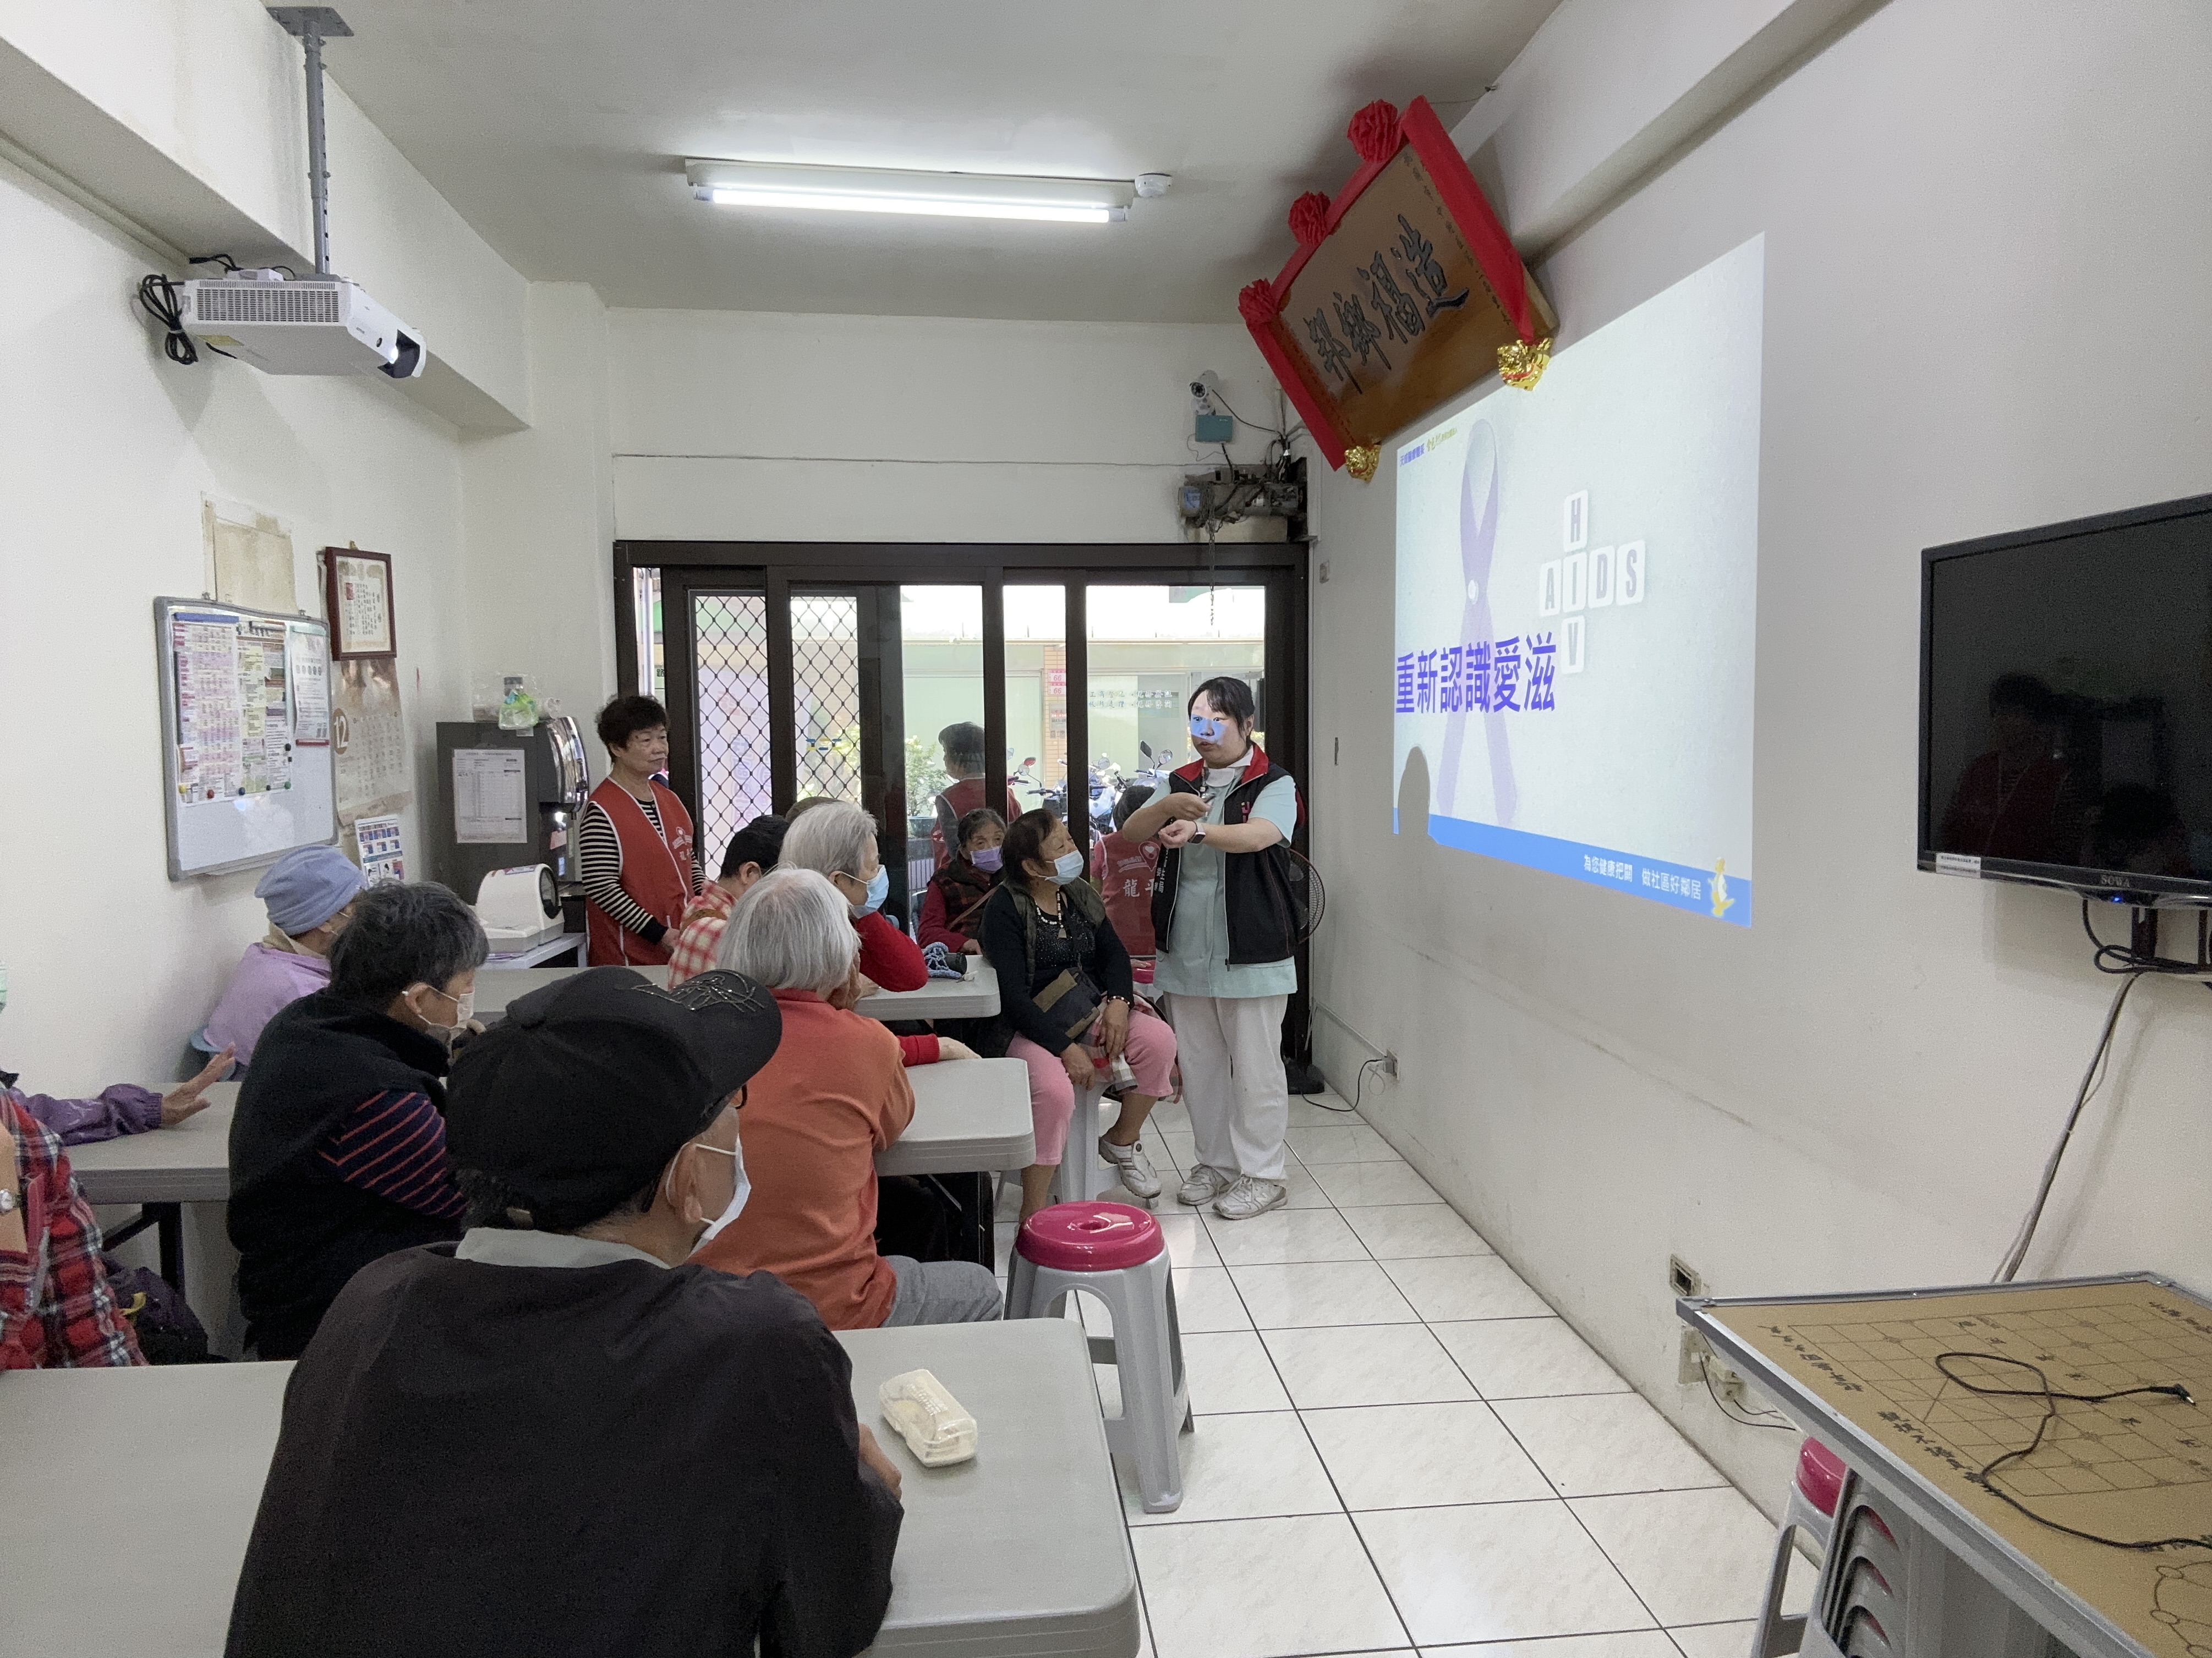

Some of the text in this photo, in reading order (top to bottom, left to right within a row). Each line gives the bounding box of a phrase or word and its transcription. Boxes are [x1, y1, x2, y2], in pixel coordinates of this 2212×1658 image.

[1545, 548, 1638, 611] AIDS
[1395, 631, 1557, 714] 重新認識愛滋
[333, 716, 348, 748] 12
[1584, 854, 1702, 901] 為您健康把關 做社區好鄰居
